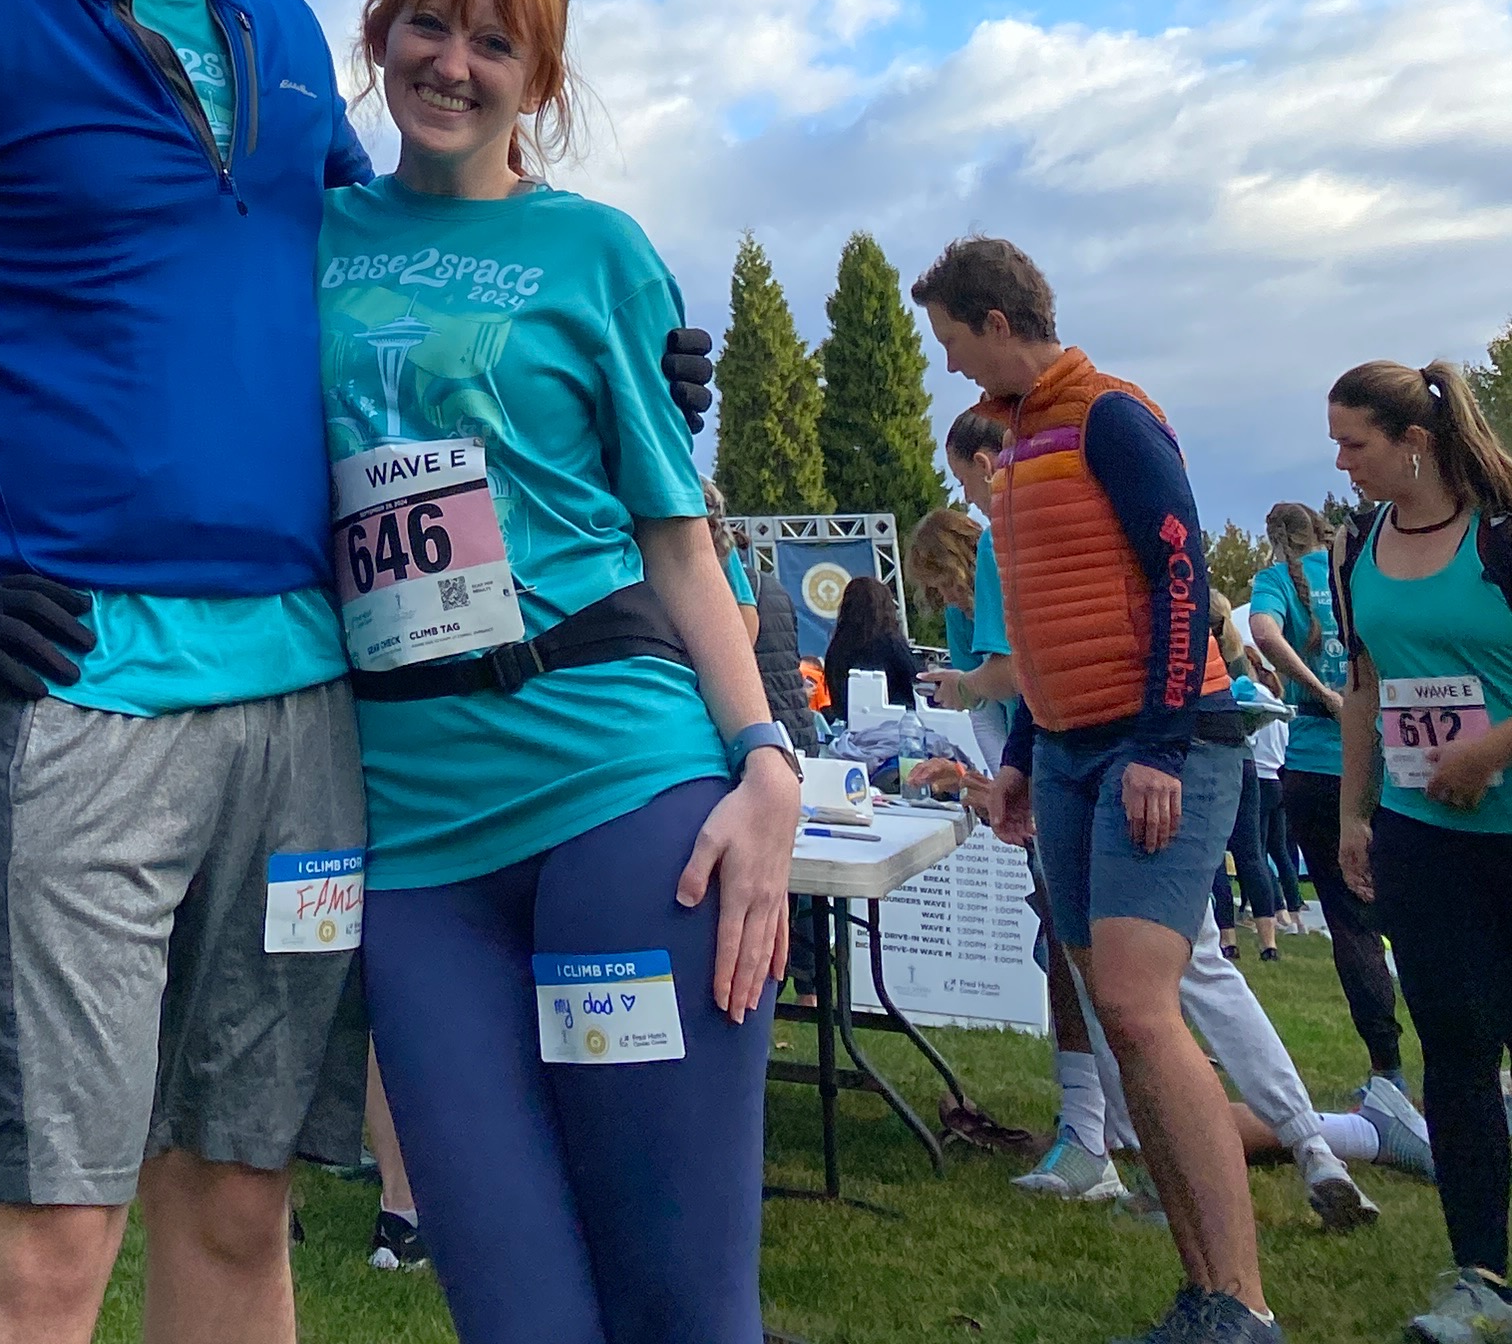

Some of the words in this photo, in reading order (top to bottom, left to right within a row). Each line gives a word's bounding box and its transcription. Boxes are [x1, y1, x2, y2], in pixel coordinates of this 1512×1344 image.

[467, 286, 526, 311] 2024
[365, 453, 440, 489] WAVE
[451, 449, 466, 468] E
[348, 504, 452, 594] 646
[410, 626, 438, 640] CLIMB
[440, 622, 460, 634] TAG
[1165, 552, 1197, 708] Columbia
[1415, 685, 1458, 699] WAVE
[1463, 685, 1473, 696] E
[1399, 711, 1461, 746] 612
[298, 862, 302, 873] I
[306, 860, 341, 873] CLIMB
[343, 856, 362, 870] FOR
[923, 875, 950, 884] BREAK
[920, 887, 942, 895] WAVE
[923, 900, 946, 908] WAVE
[922, 912, 944, 920] WAVE
[921, 924, 943, 932] WAVE
[884, 932, 920, 941] DRIVE-IN
[922, 936, 944, 944] WAVE
[883, 944, 918, 953] DRIVE-IN
[557, 964, 561, 976] I
[564, 964, 602, 978] CLIMB
[605, 963, 636, 976] FOR
[554, 998, 574, 1029] my
[583, 992, 614, 1015] dad
